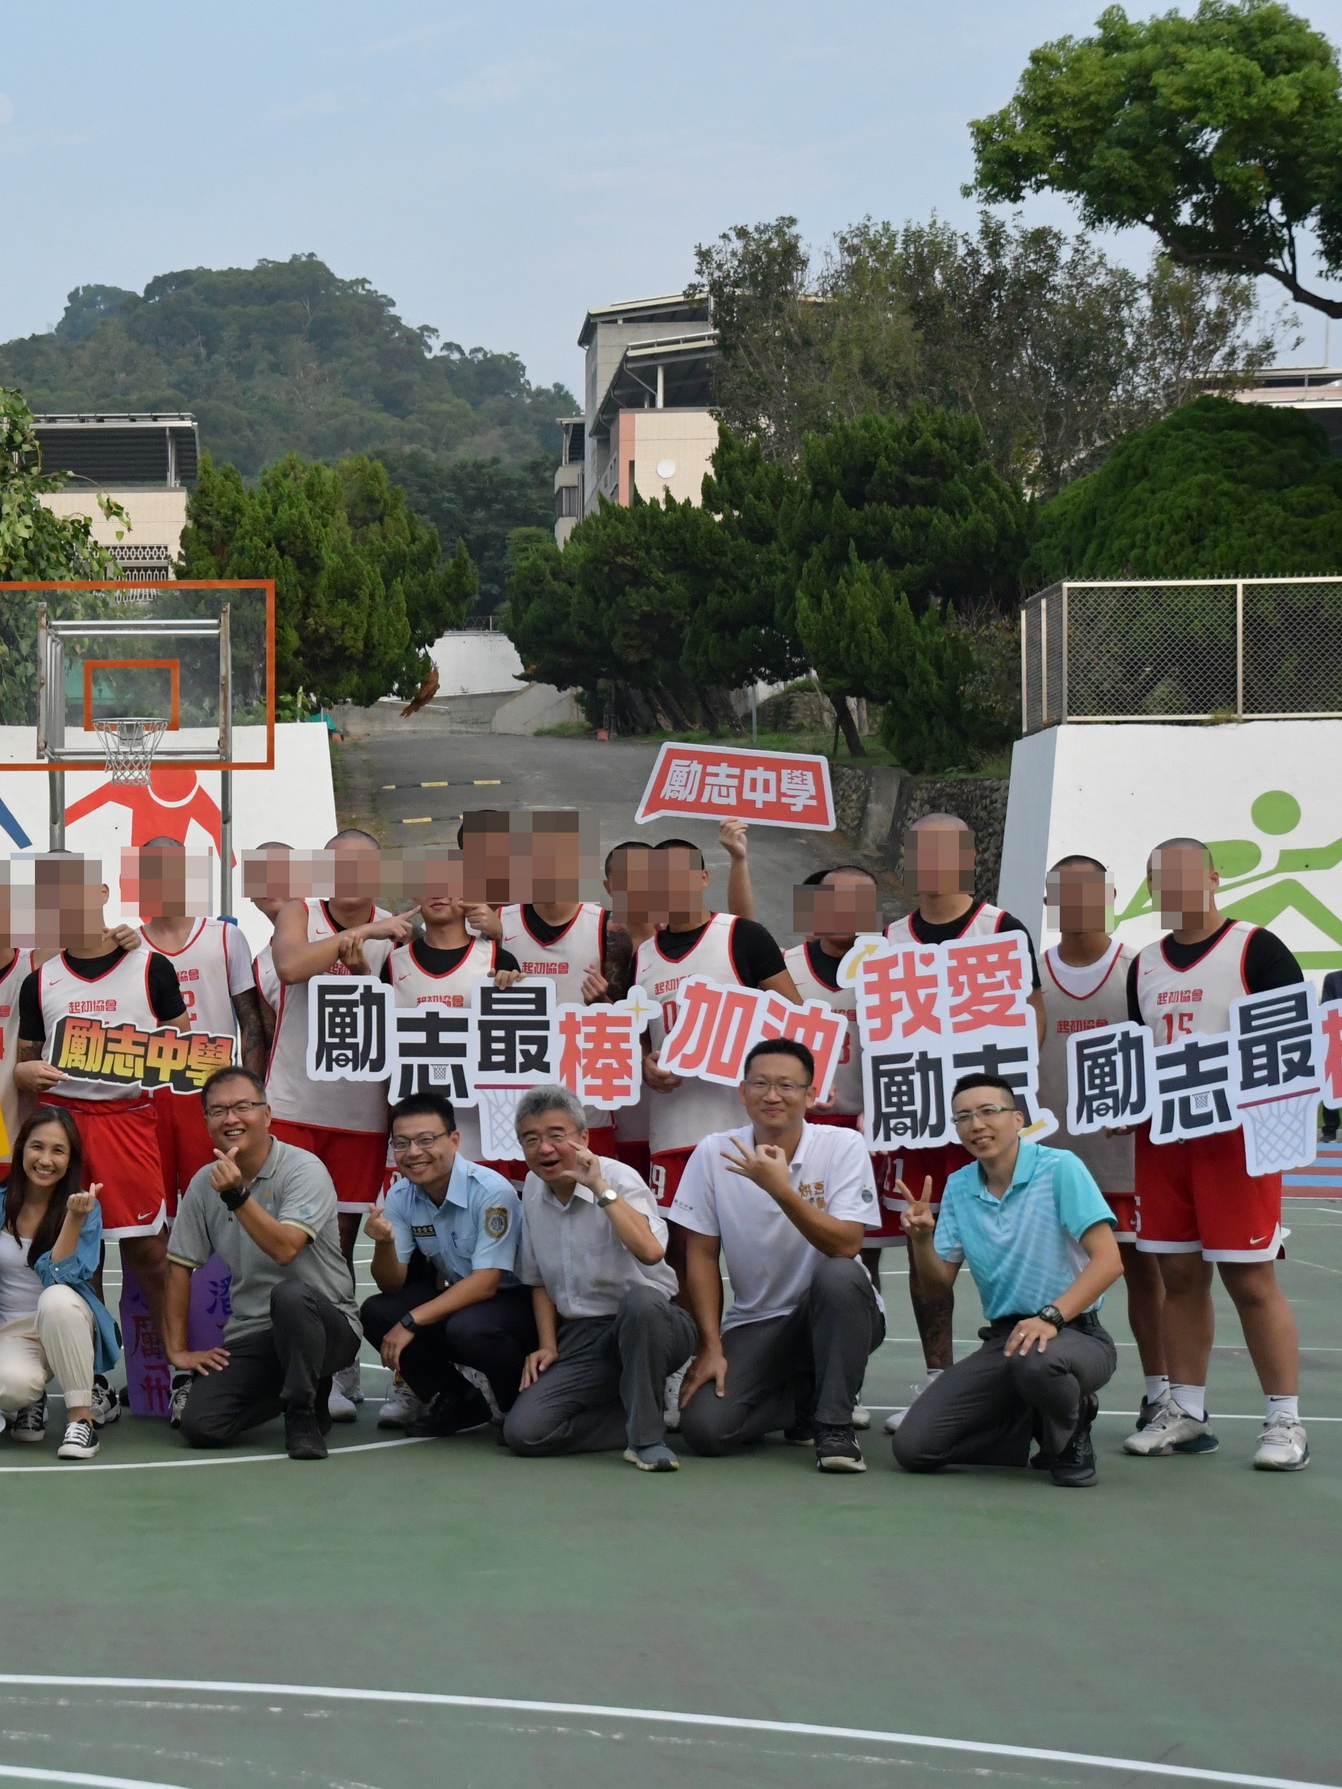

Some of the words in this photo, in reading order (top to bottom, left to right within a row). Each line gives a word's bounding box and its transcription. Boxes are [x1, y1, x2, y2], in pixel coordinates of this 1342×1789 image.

[660, 759, 817, 812] 勵志中學
[176, 969, 199, 982] 協會
[522, 962, 570, 975] 起初協會
[654, 975, 687, 995] 起初
[68, 999, 117, 1014] 起初協會
[862, 939, 1027, 1042] 我愛
[1157, 988, 1204, 1005] 起初協會
[315, 985, 633, 1101] 勵志最棒
[666, 981, 840, 1098] 加油
[1162, 1012, 1193, 1045] 15
[58, 1017, 234, 1087] 勵志中學
[871, 1043, 1033, 1142] 勵志
